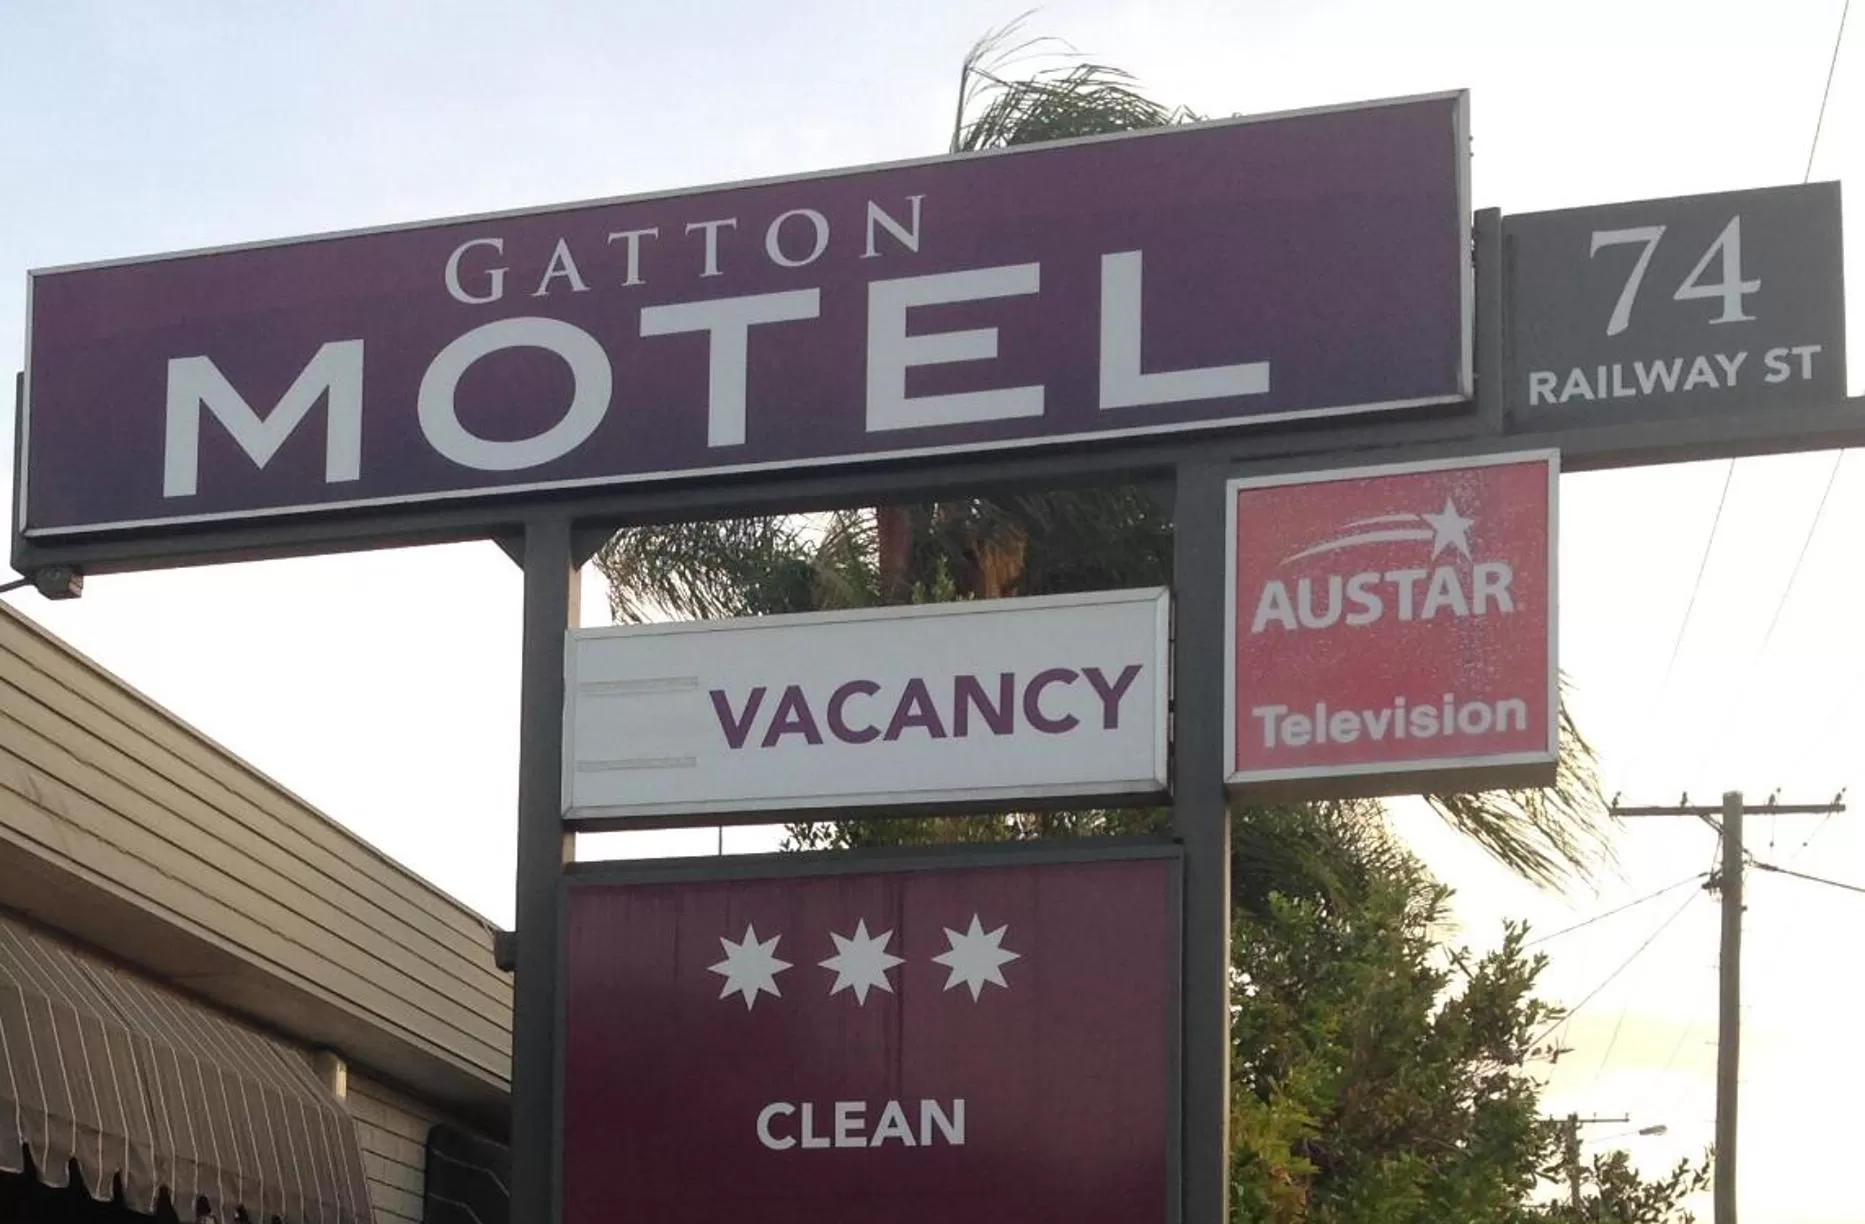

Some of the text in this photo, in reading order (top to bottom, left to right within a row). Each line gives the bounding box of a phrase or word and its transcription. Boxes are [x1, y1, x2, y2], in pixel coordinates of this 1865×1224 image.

[444, 194, 927, 305] GATTON
[1588, 213, 1762, 338] 74
[162, 249, 1270, 500] MOTEL
[1528, 345, 1822, 406] RAILWAY ST
[1251, 562, 1516, 634] AUSTAR
[709, 664, 1143, 750] VACANCY
[1252, 694, 1528, 750] Television
[755, 1098, 966, 1151] CLEAN
